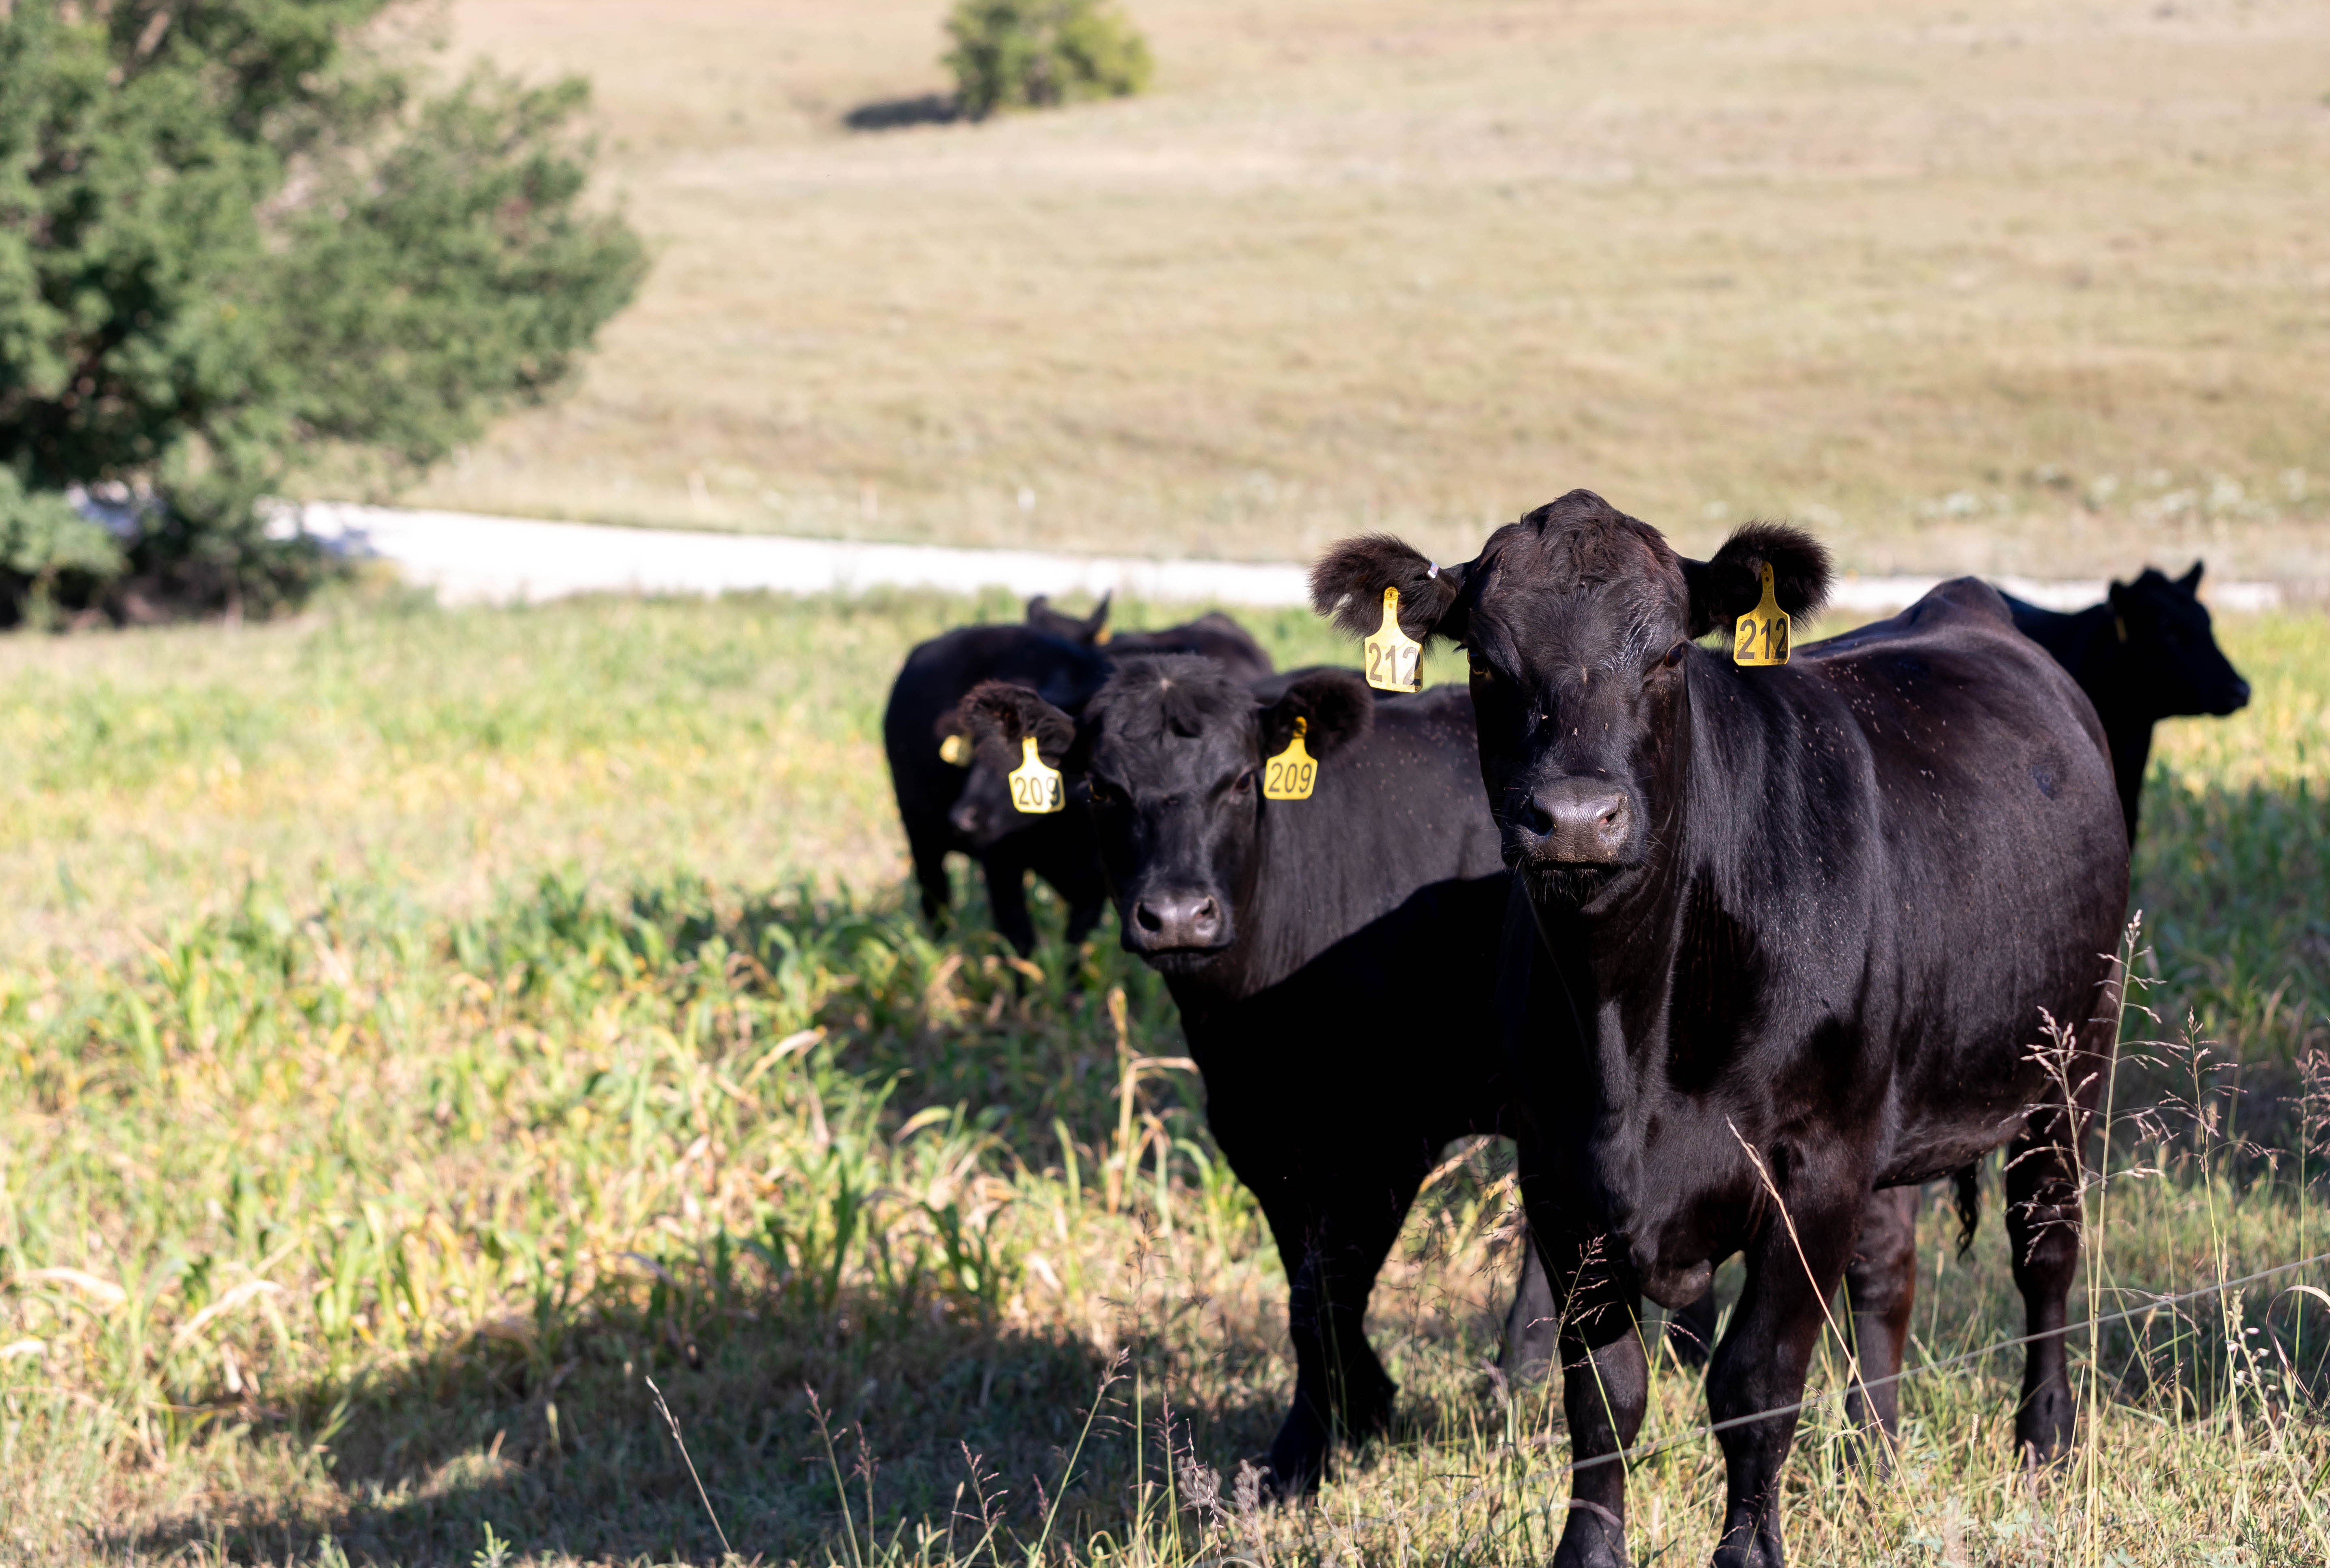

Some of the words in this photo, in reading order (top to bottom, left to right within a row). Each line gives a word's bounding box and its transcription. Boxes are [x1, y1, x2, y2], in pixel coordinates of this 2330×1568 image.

[1737, 618, 1787, 659] 212
[1369, 642, 1421, 685] 212
[1015, 777, 1060, 806] 209
[1269, 762, 1312, 793] 209
